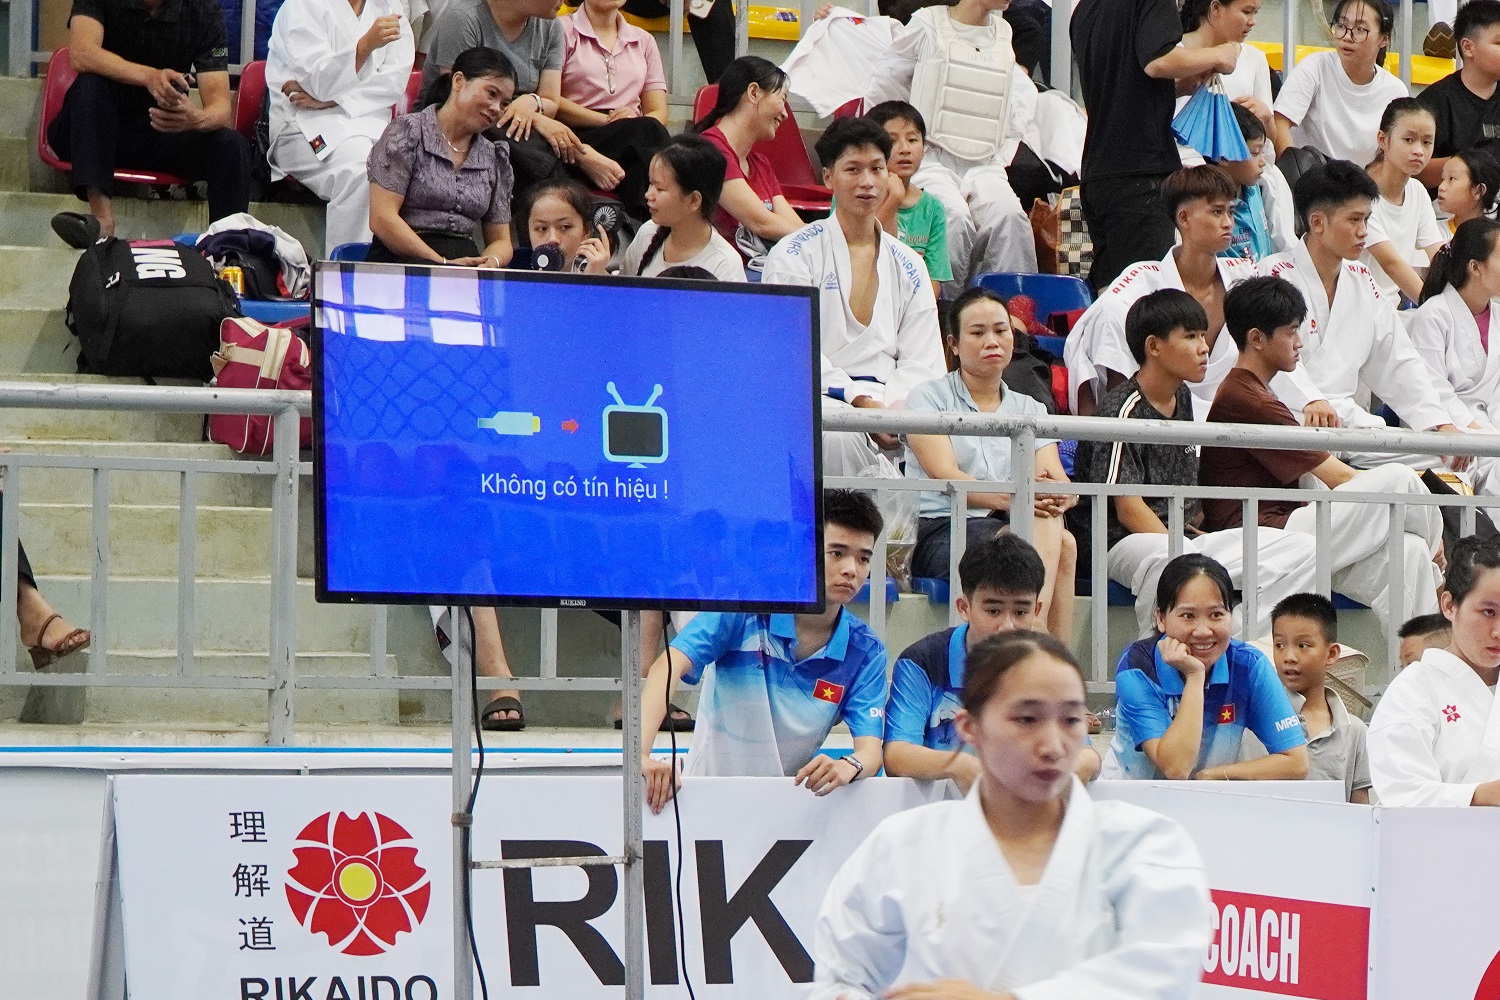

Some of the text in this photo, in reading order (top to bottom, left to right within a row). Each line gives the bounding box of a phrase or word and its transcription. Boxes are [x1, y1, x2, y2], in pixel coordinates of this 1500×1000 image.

[786, 223, 824, 256] SHINRAIDO
[131, 247, 187, 280] NG
[481, 473, 546, 500] Không
[553, 476, 577, 496] có
[583, 476, 608, 497] tín
[615, 477, 657, 502] hiệu
[1201, 901, 1300, 985] COACH
